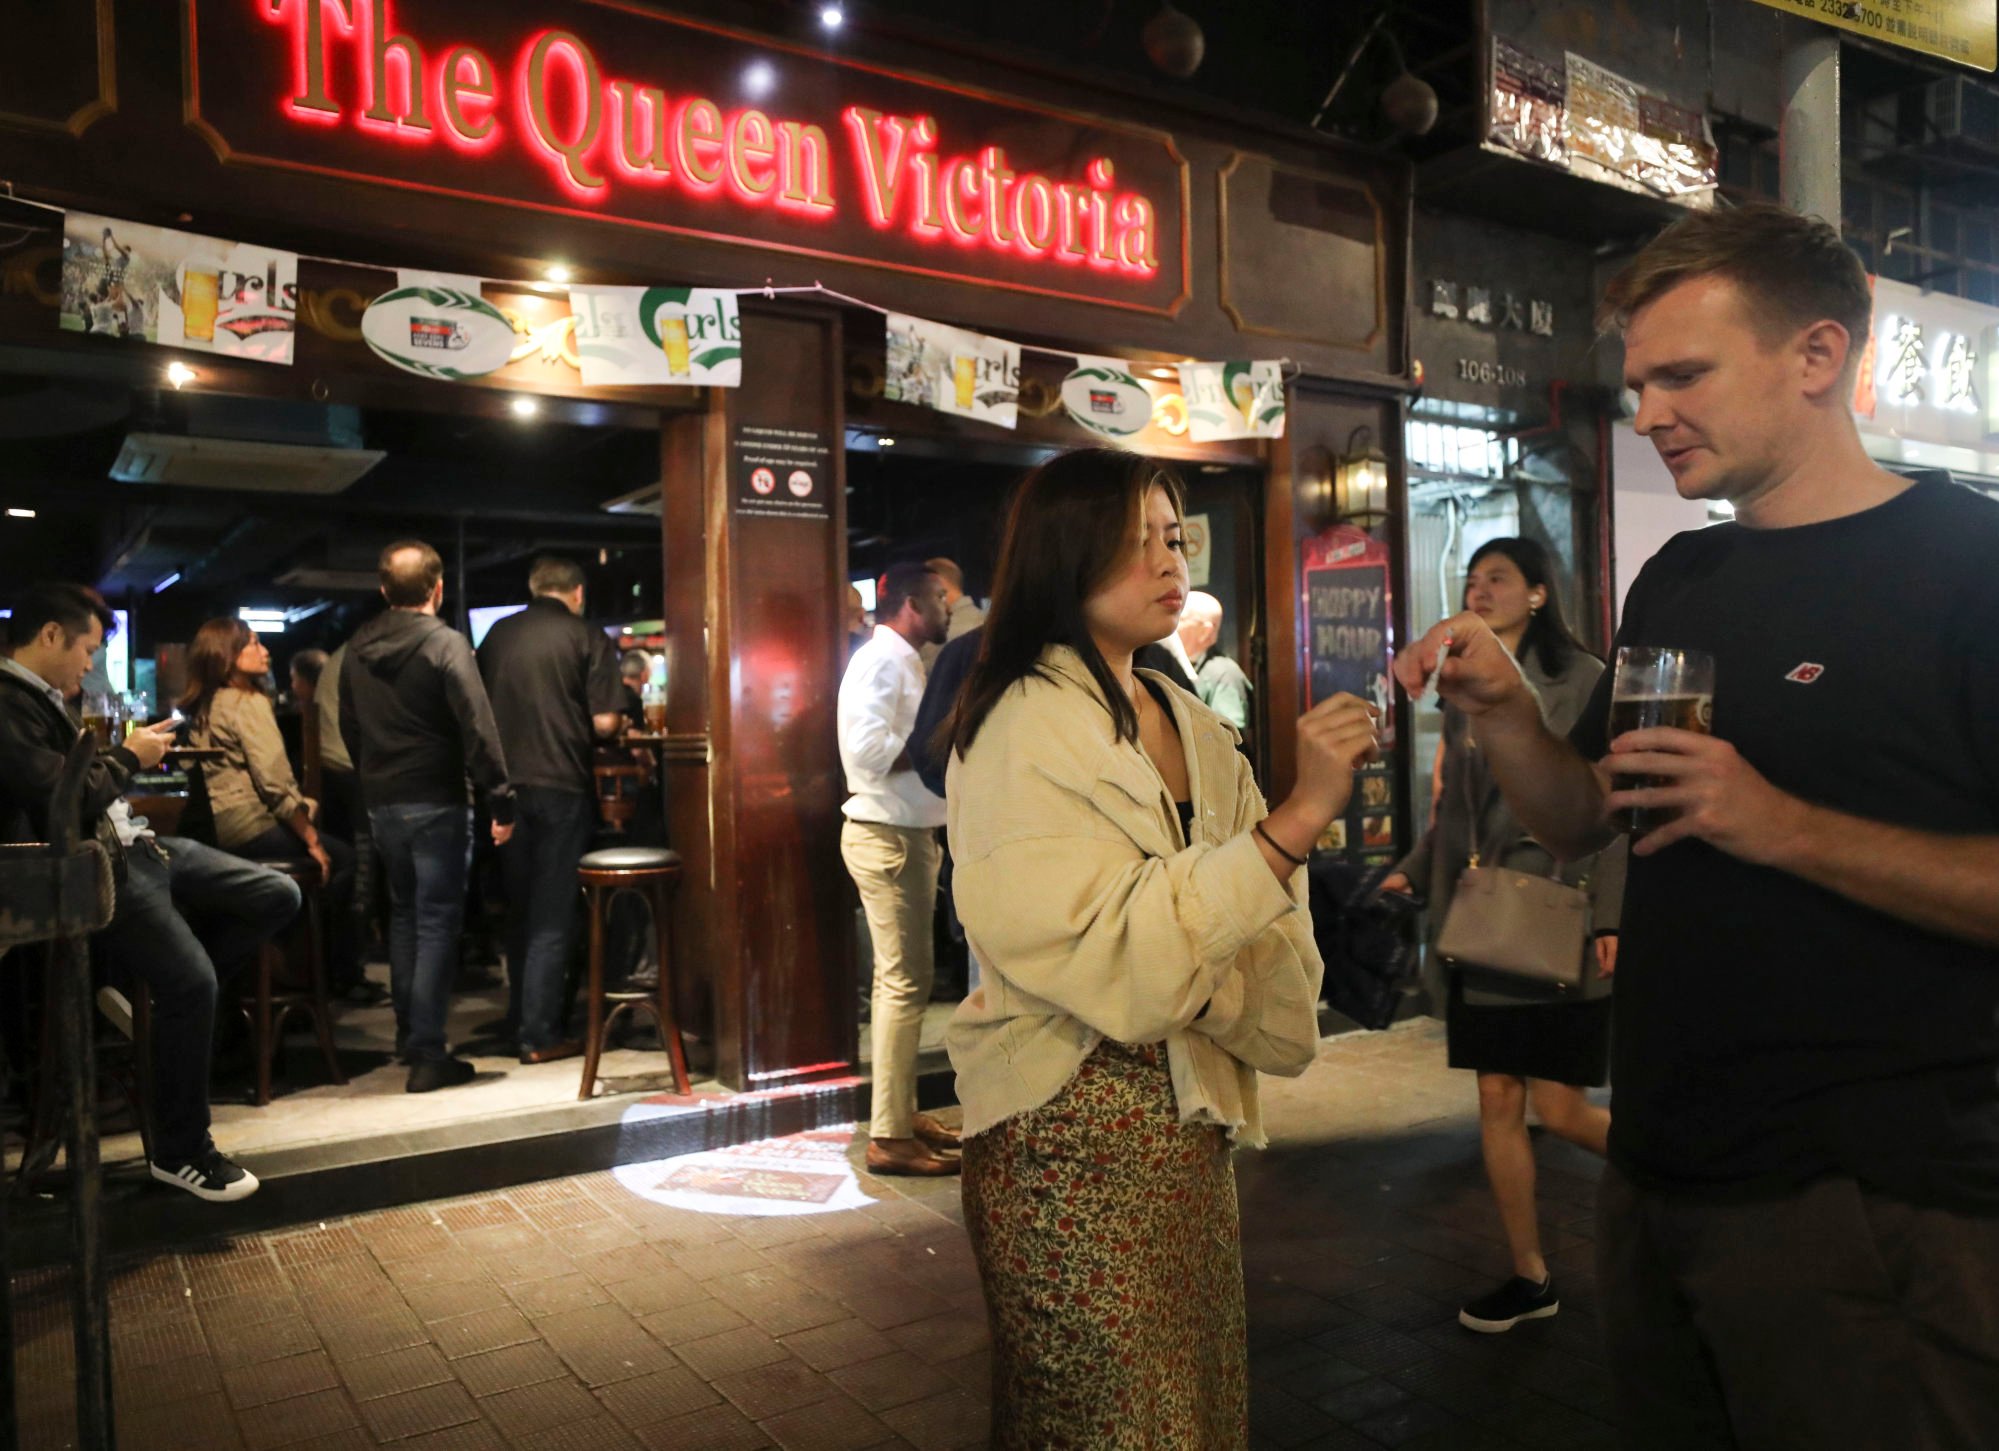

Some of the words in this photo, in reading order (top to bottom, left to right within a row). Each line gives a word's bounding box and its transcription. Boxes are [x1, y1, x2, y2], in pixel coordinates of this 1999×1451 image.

[1820, 0, 1883, 29] 2332700
[262, 0, 496, 143] The
[524, 31, 836, 213] Queen
[849, 107, 1158, 270] Victoria
[1317, 624, 1381, 660] HOUR
